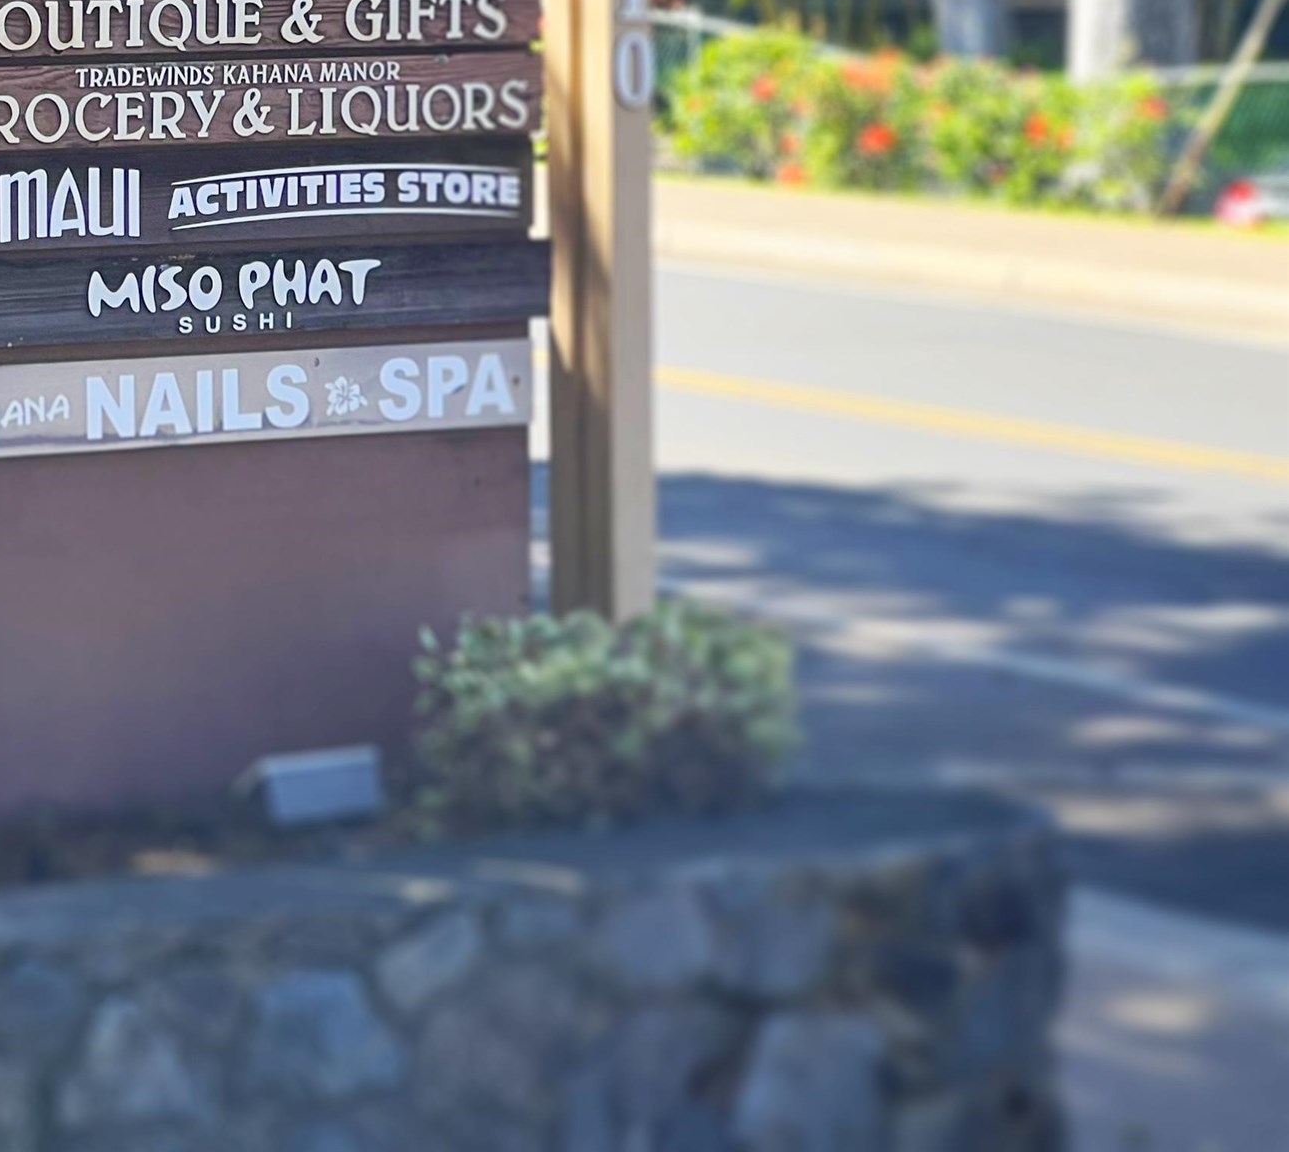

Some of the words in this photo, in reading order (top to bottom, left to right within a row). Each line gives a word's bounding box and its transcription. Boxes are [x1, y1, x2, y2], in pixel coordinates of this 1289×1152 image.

[75, 66, 215, 89] TRADEWINDS
[222, 64, 315, 85] KAHANA
[319, 62, 401, 82] MANOR
[233, 89, 276, 137] &
[288, 80, 529, 136] LIQUORS
[0, 168, 140, 243] MAUI
[169, 171, 386, 220] ACTIVITIES
[398, 171, 521, 207] STORE
[88, 264, 223, 318] MISO
[239, 259, 381, 312] PHAT
[178, 312, 293, 335] SUSHI
[85, 364, 311, 441] NAILS
[379, 353, 514, 422] SPA
